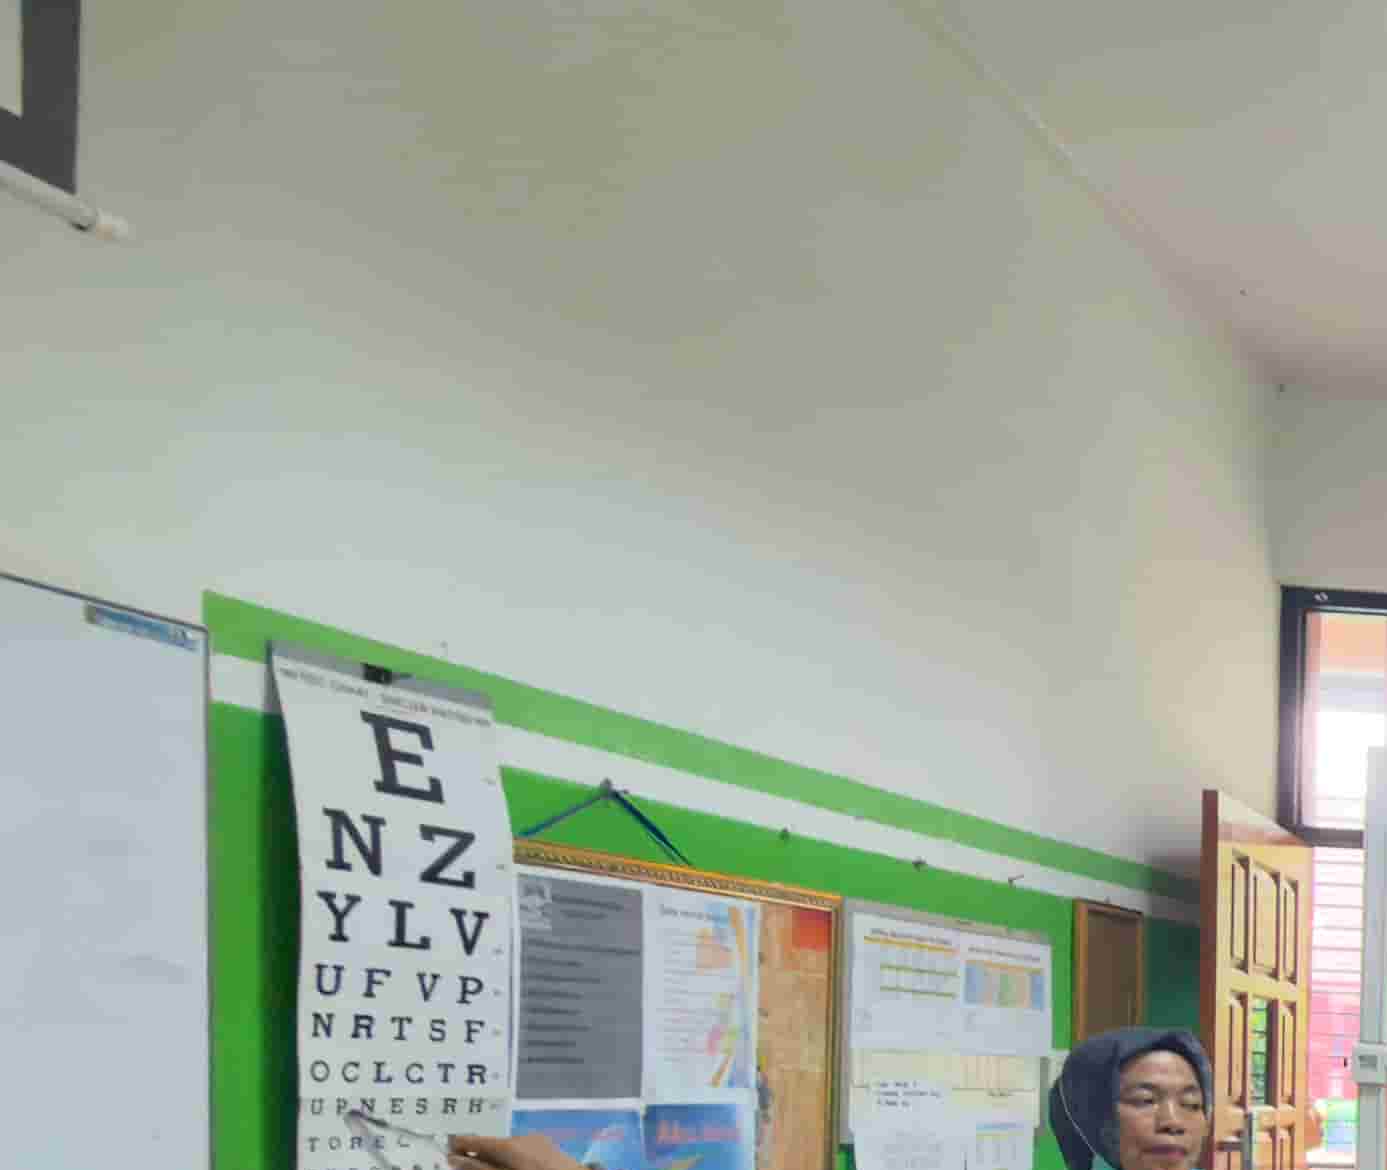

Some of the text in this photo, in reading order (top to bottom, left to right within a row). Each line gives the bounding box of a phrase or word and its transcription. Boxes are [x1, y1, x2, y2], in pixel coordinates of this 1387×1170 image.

[360, 711, 444, 804] E
[323, 808, 475, 889] N Z
[317, 891, 489, 956] Y L V
[315, 964, 483, 1004] U F V P
[312, 1012, 485, 1043] N R T S F
[310, 1060, 486, 1084] O C L C T R
